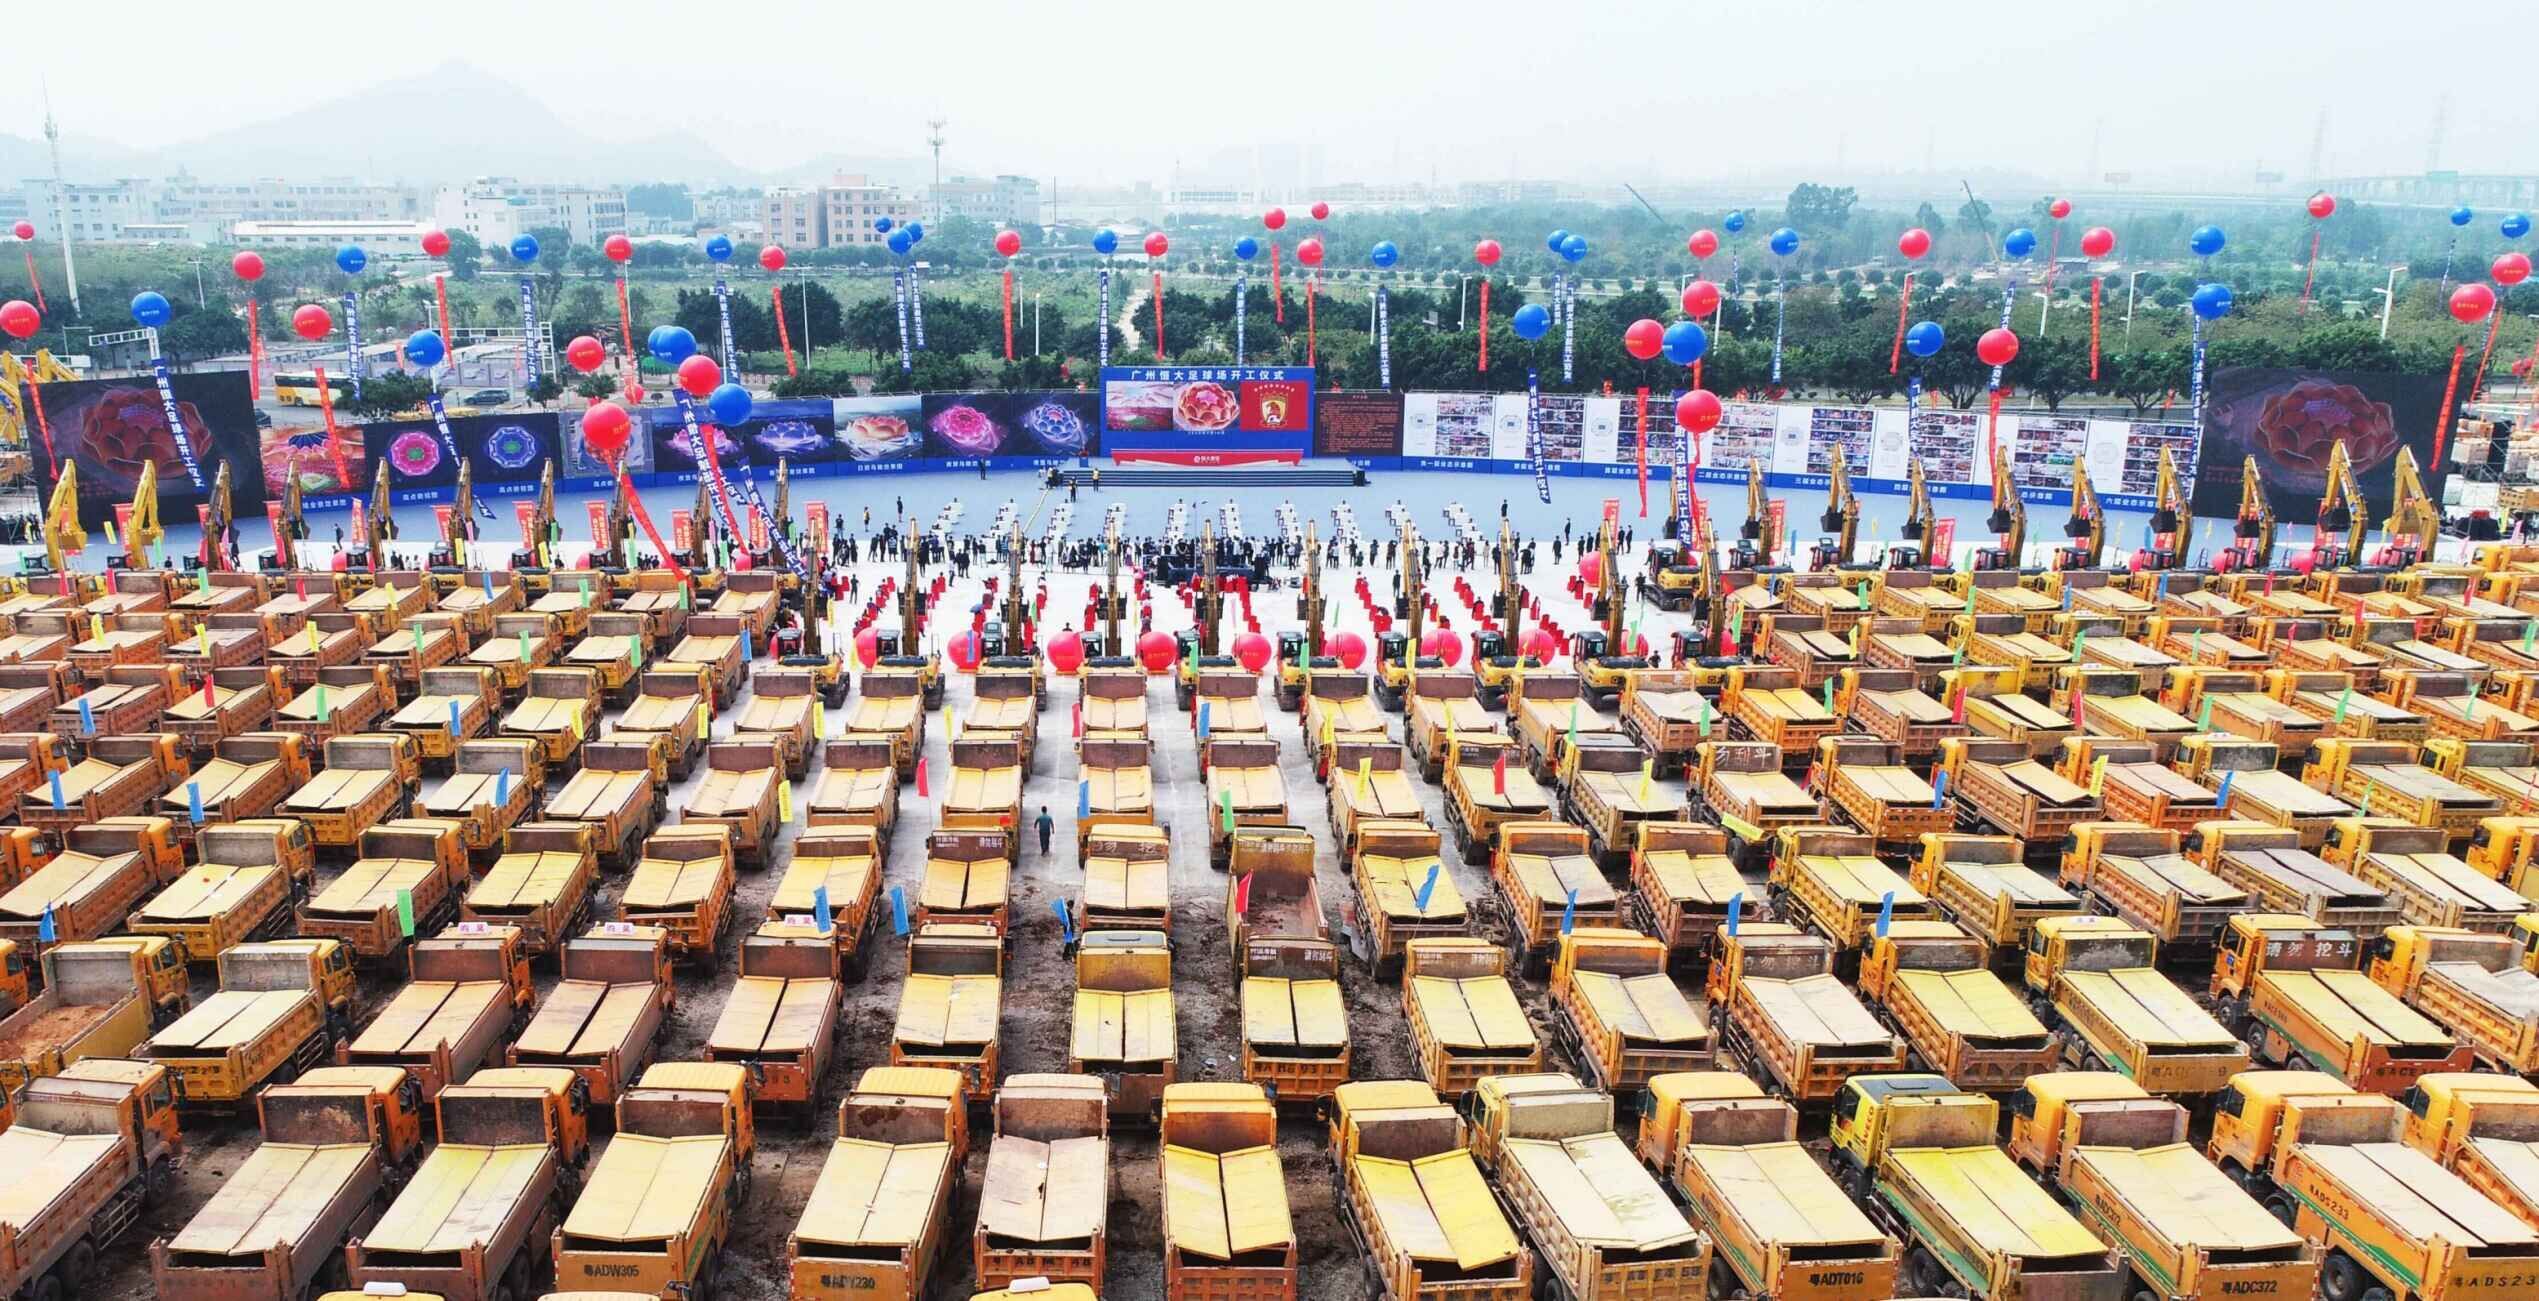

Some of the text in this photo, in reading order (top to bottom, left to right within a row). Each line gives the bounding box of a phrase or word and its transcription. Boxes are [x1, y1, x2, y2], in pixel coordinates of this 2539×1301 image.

[1131, 370, 1284, 380] 广州恒大足球场开工仪式
